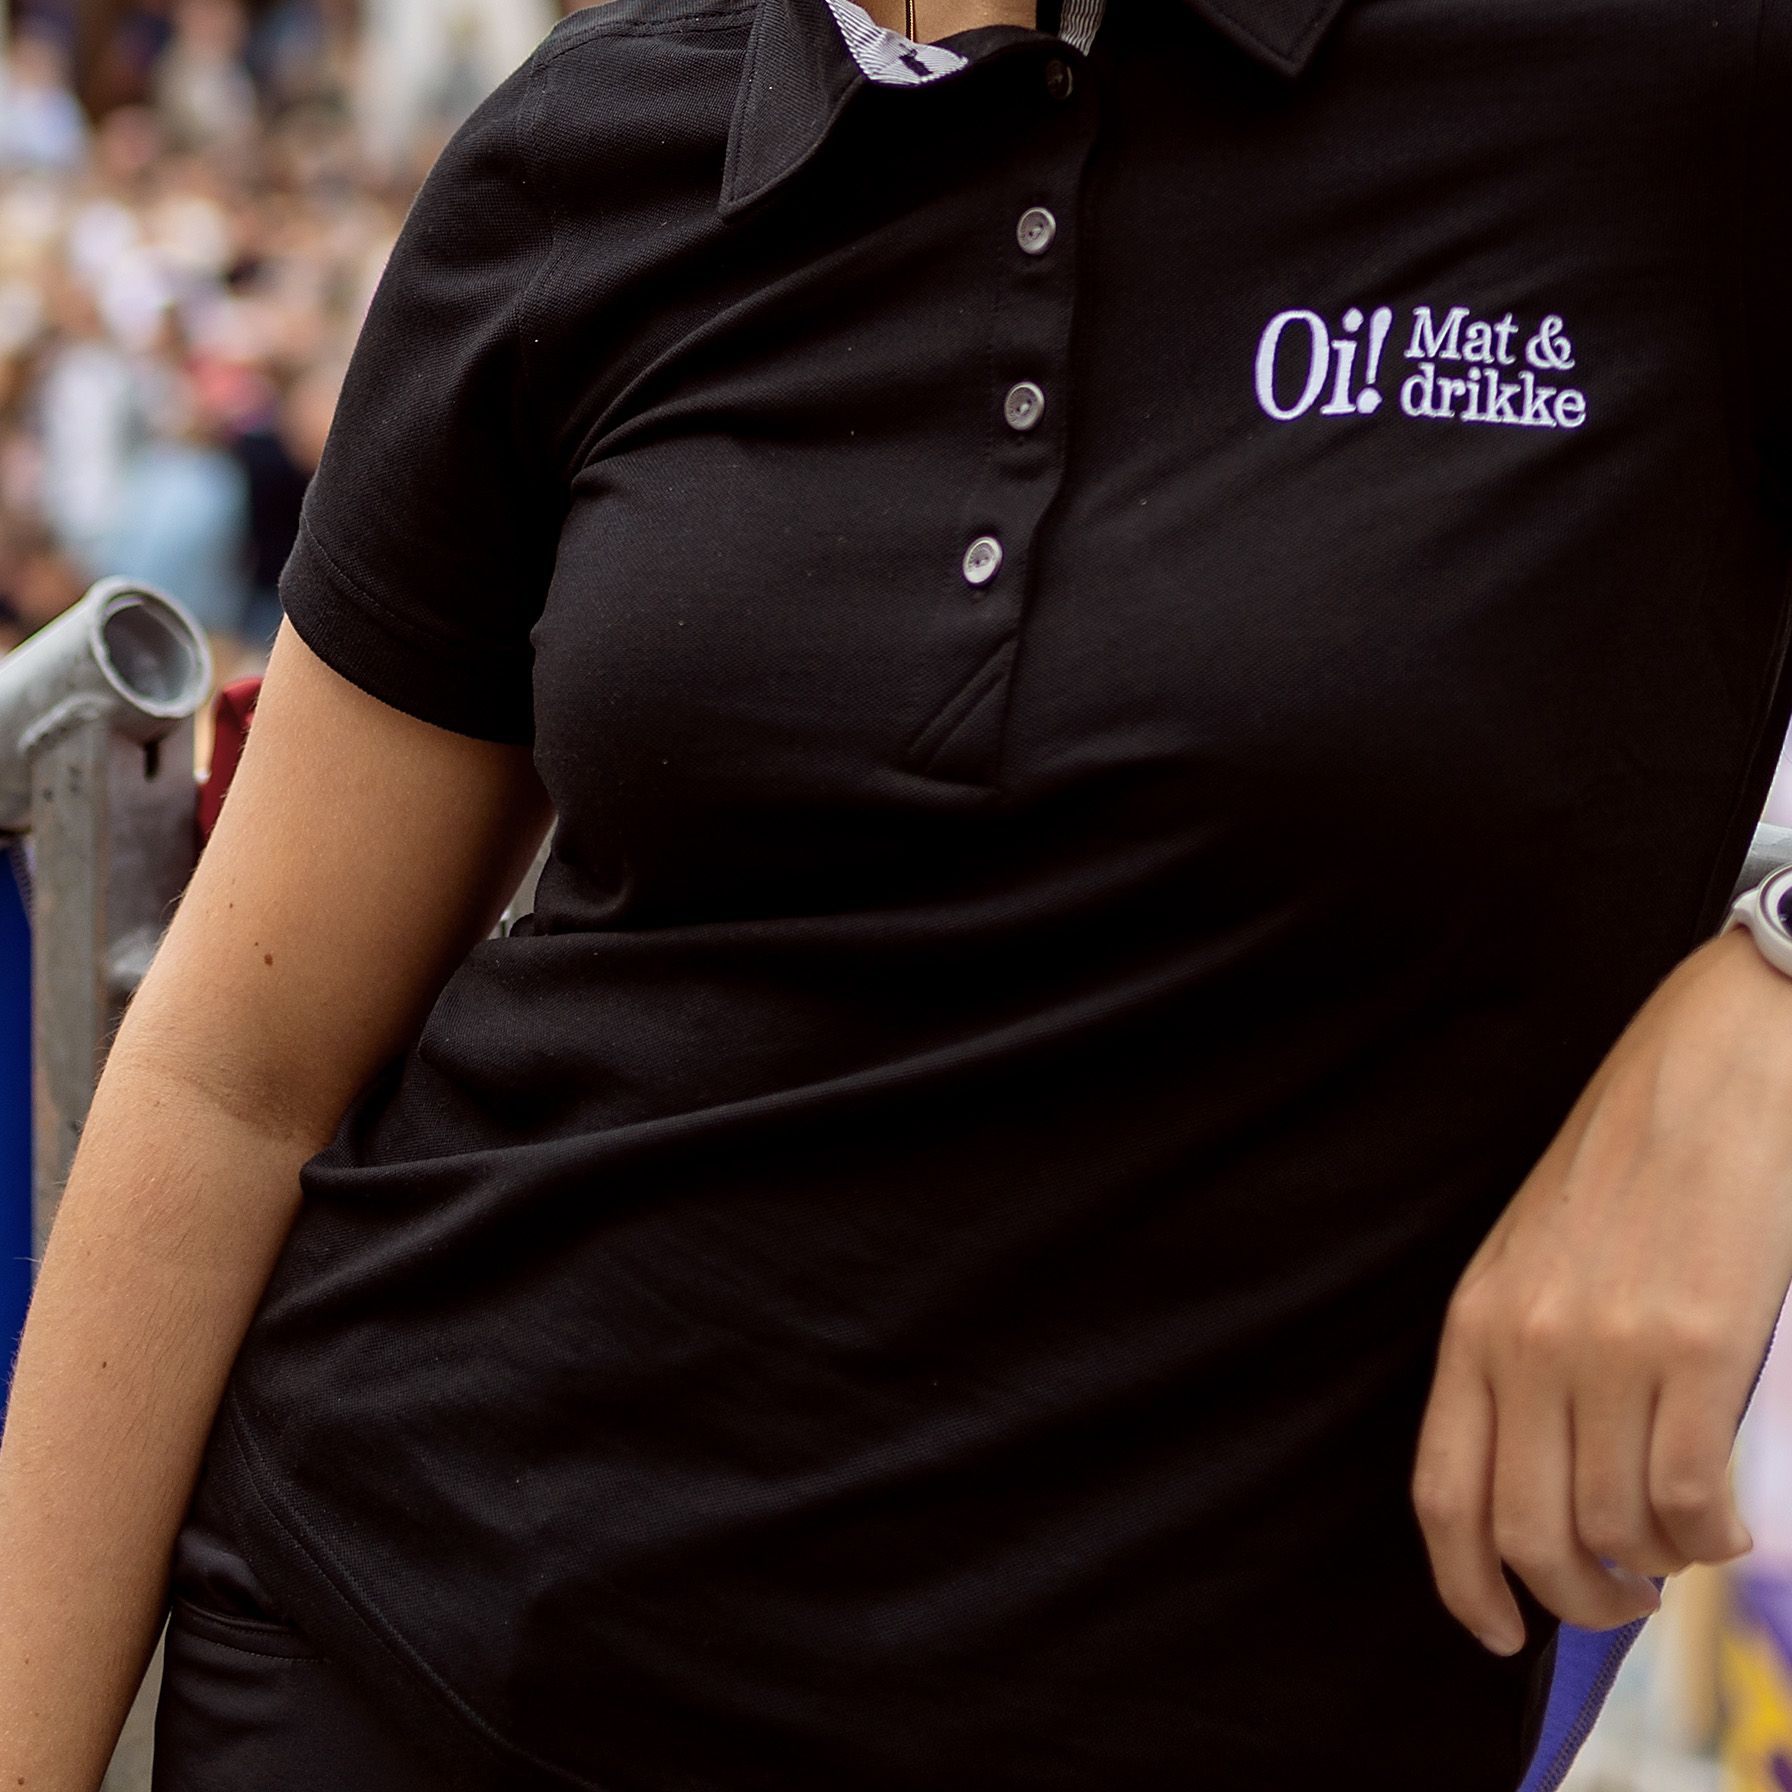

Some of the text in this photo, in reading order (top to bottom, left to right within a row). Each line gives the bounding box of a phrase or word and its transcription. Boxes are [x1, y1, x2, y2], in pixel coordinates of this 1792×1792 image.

[1254, 306, 1394, 422] Oi!
[1403, 305, 1576, 370] Mat &
[1399, 361, 1588, 429] drikke
